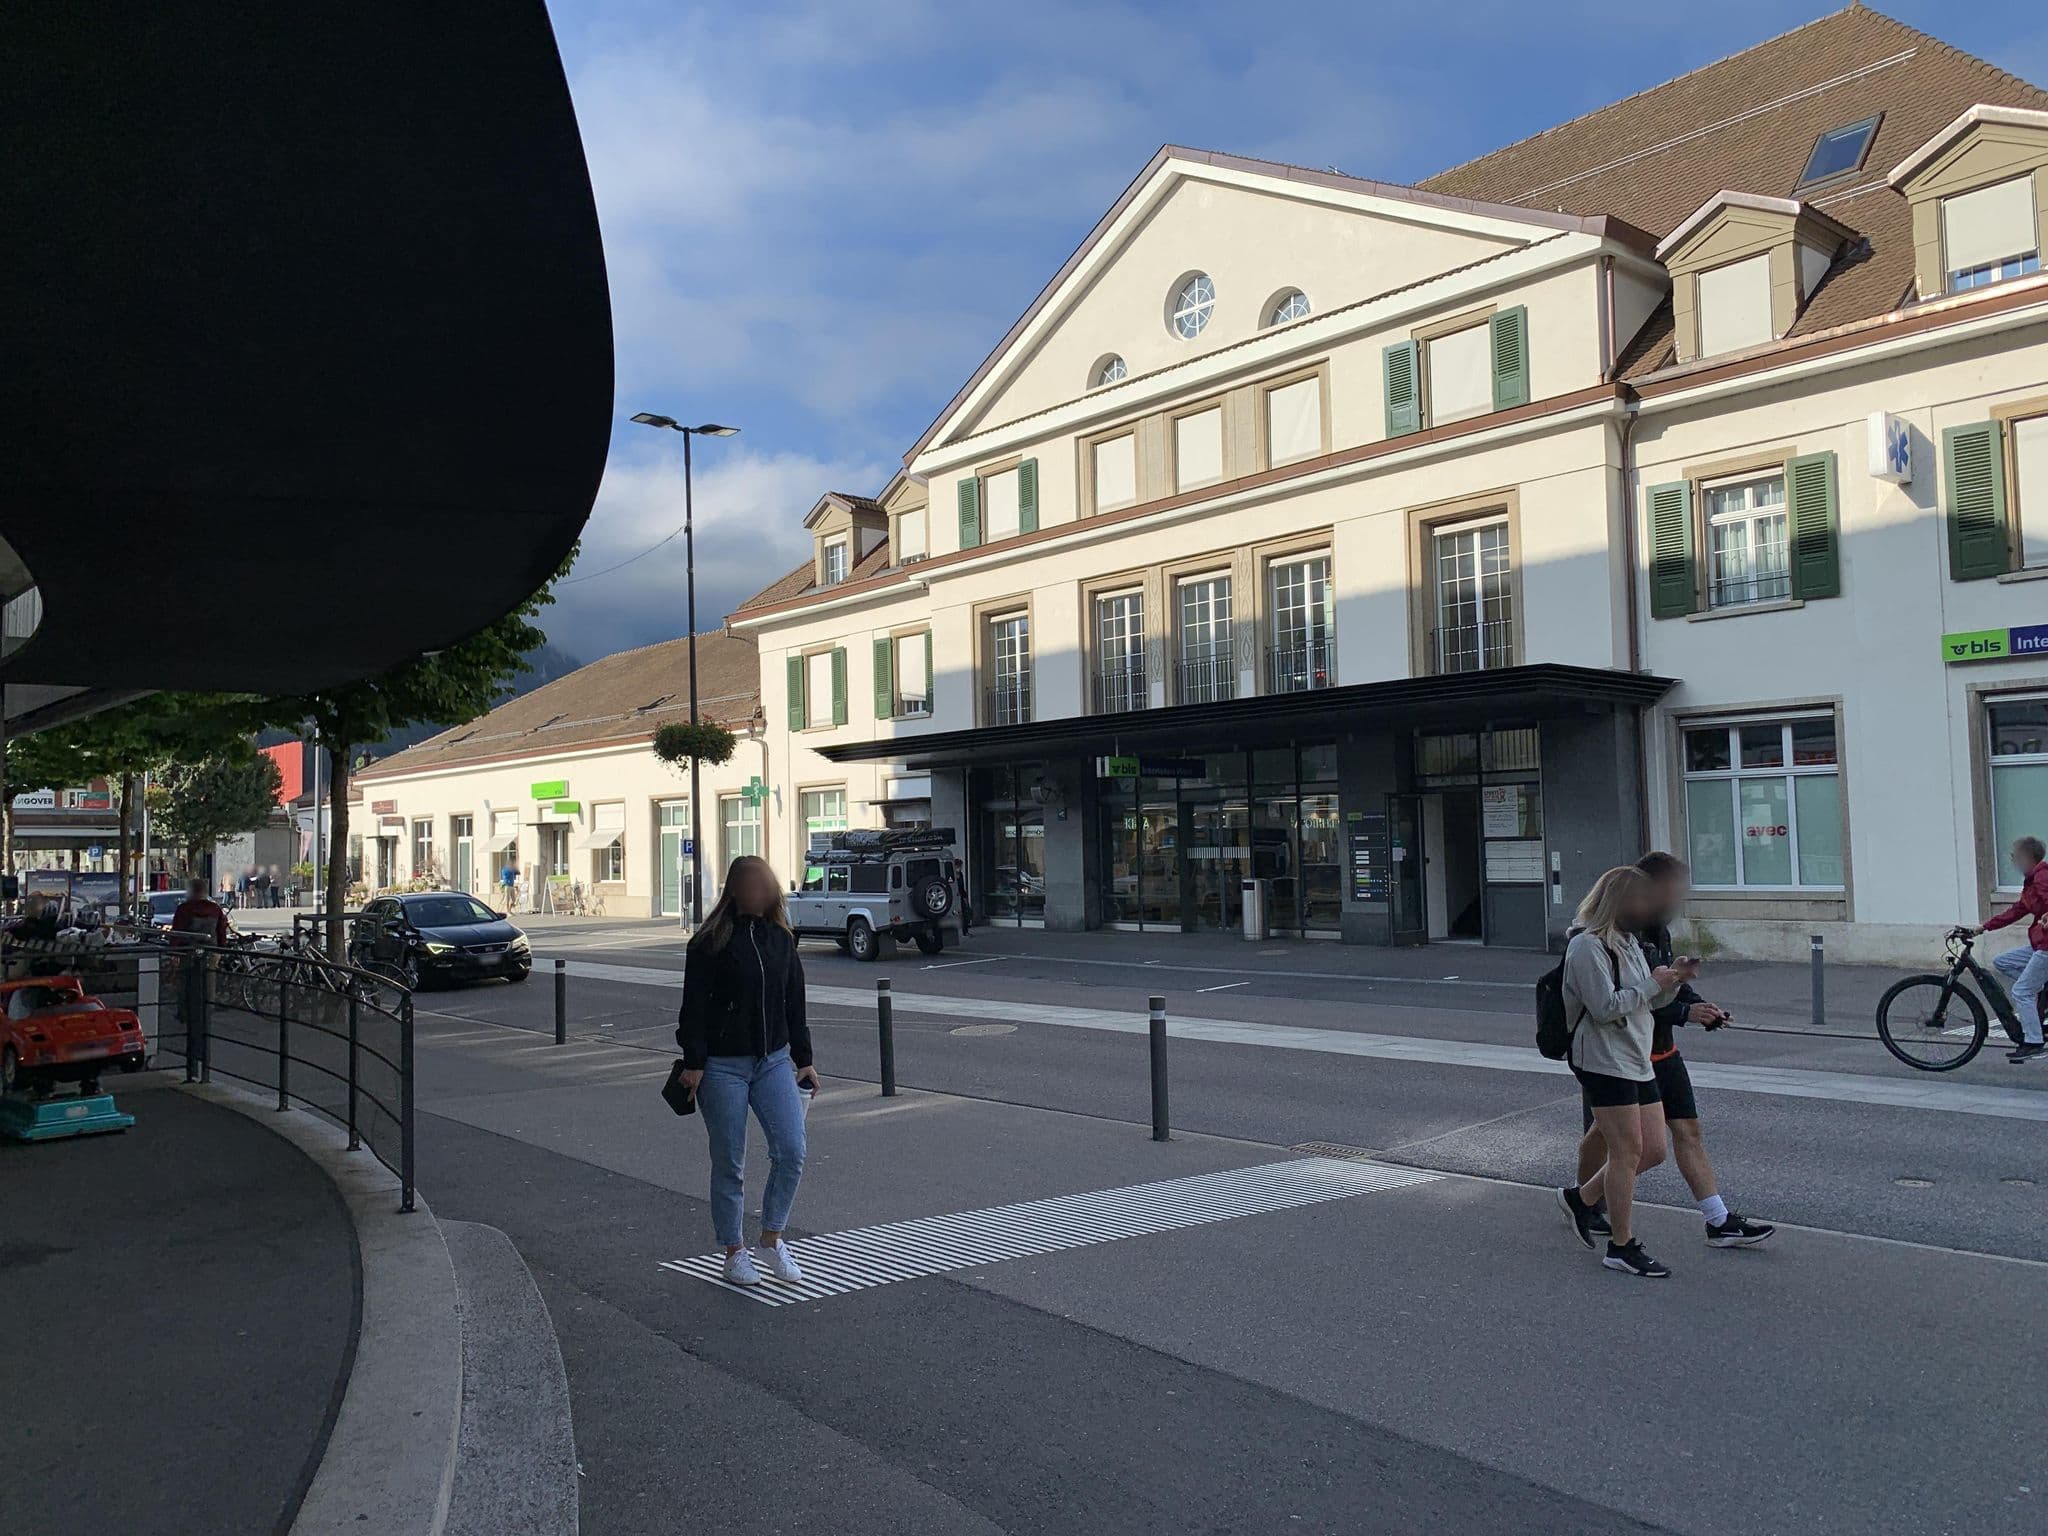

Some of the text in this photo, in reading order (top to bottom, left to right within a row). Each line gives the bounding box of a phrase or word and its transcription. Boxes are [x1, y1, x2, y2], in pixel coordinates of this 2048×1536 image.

[1971, 639, 2002, 654] bls
[1747, 825, 1788, 837] avec
[91, 848, 98, 856] P
[686, 841, 694, 852] P
